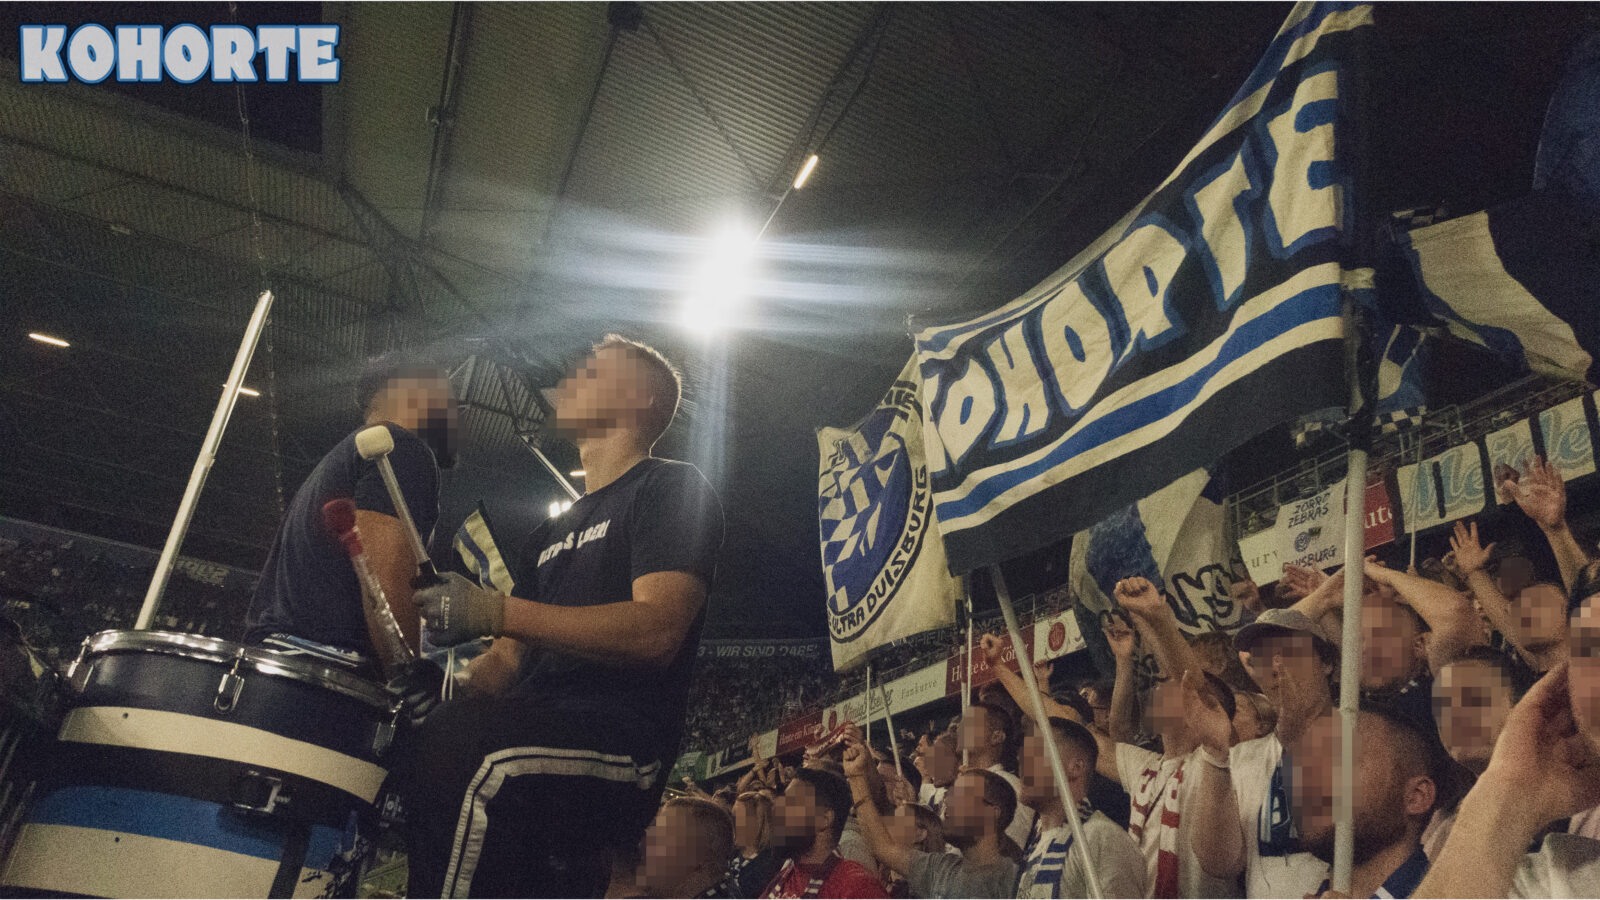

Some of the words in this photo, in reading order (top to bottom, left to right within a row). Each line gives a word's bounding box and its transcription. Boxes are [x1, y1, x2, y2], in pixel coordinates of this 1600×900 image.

[1288, 503, 1329, 529] ZEBRAS
[832, 609, 866, 635] ULTRA
[866, 464, 928, 614] DUISBURG
[716, 645, 740, 658] WIR
[742, 645, 775, 658] SIND
